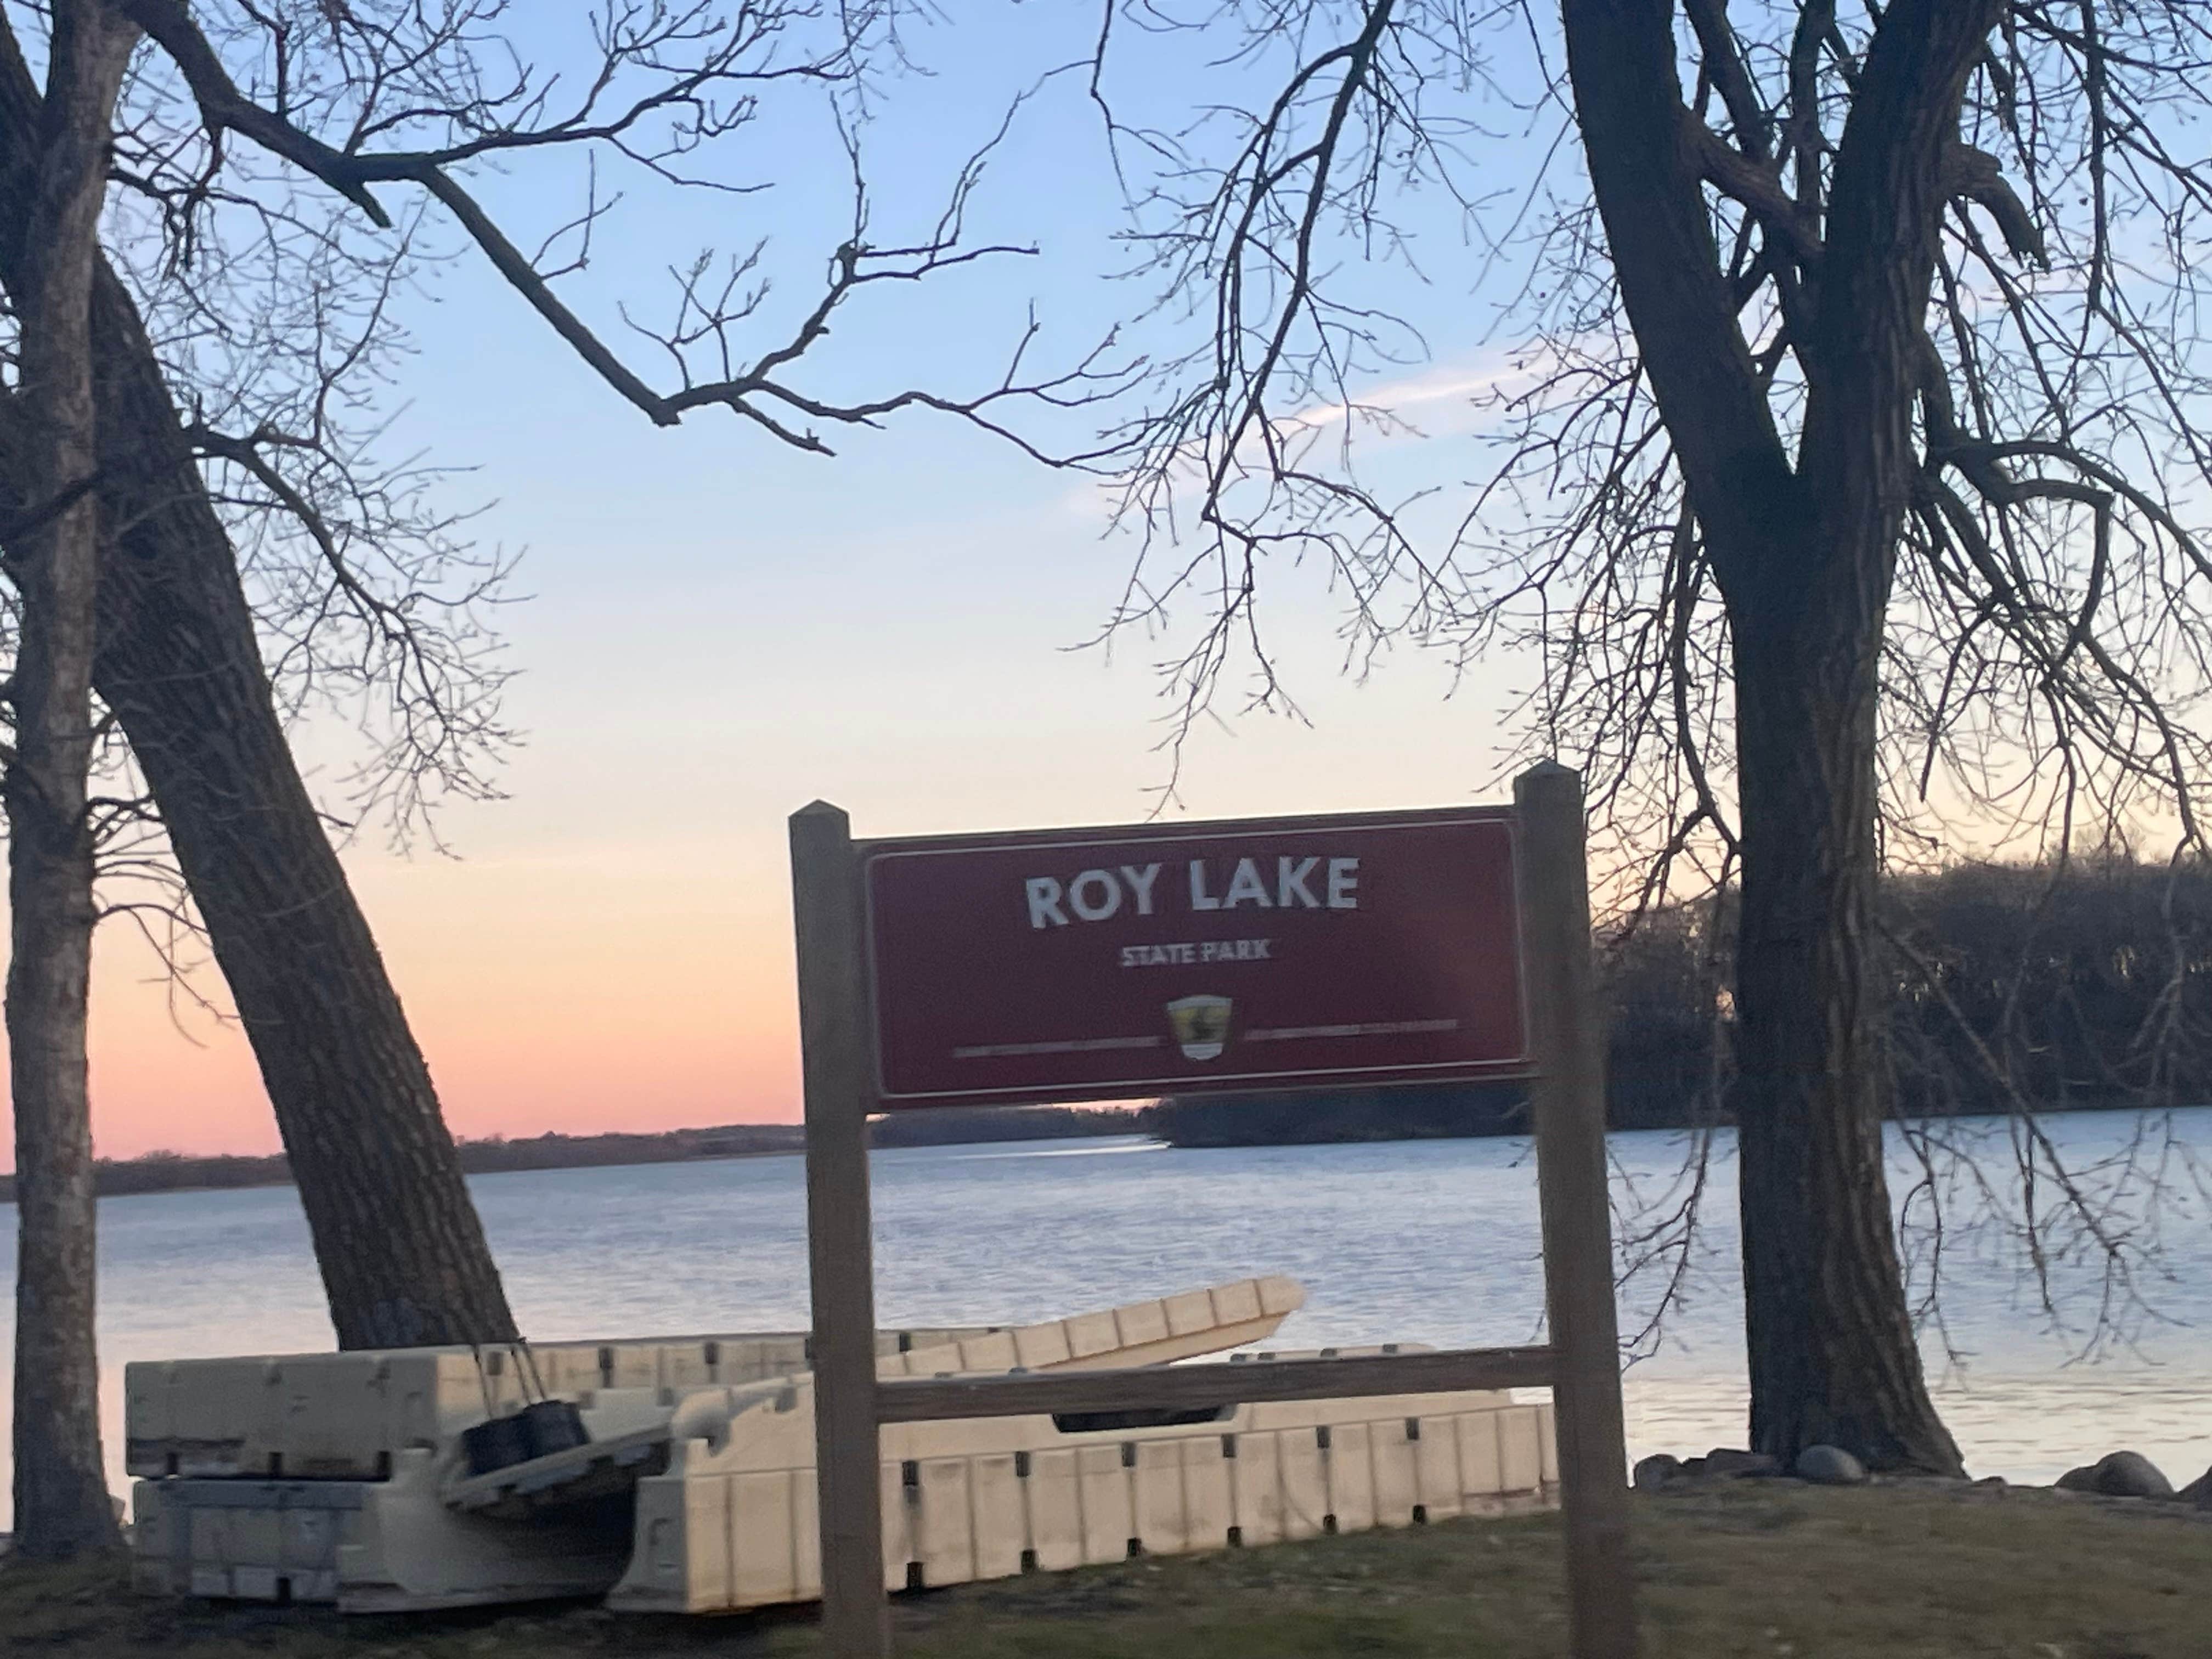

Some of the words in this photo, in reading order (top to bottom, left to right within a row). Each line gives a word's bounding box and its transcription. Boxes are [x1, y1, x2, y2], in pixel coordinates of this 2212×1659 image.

[1025, 862, 1162, 929] ROY
[1189, 857, 1361, 912] LAKE
[1120, 944, 1197, 967] STATE
[1201, 938, 1272, 963] PARK
